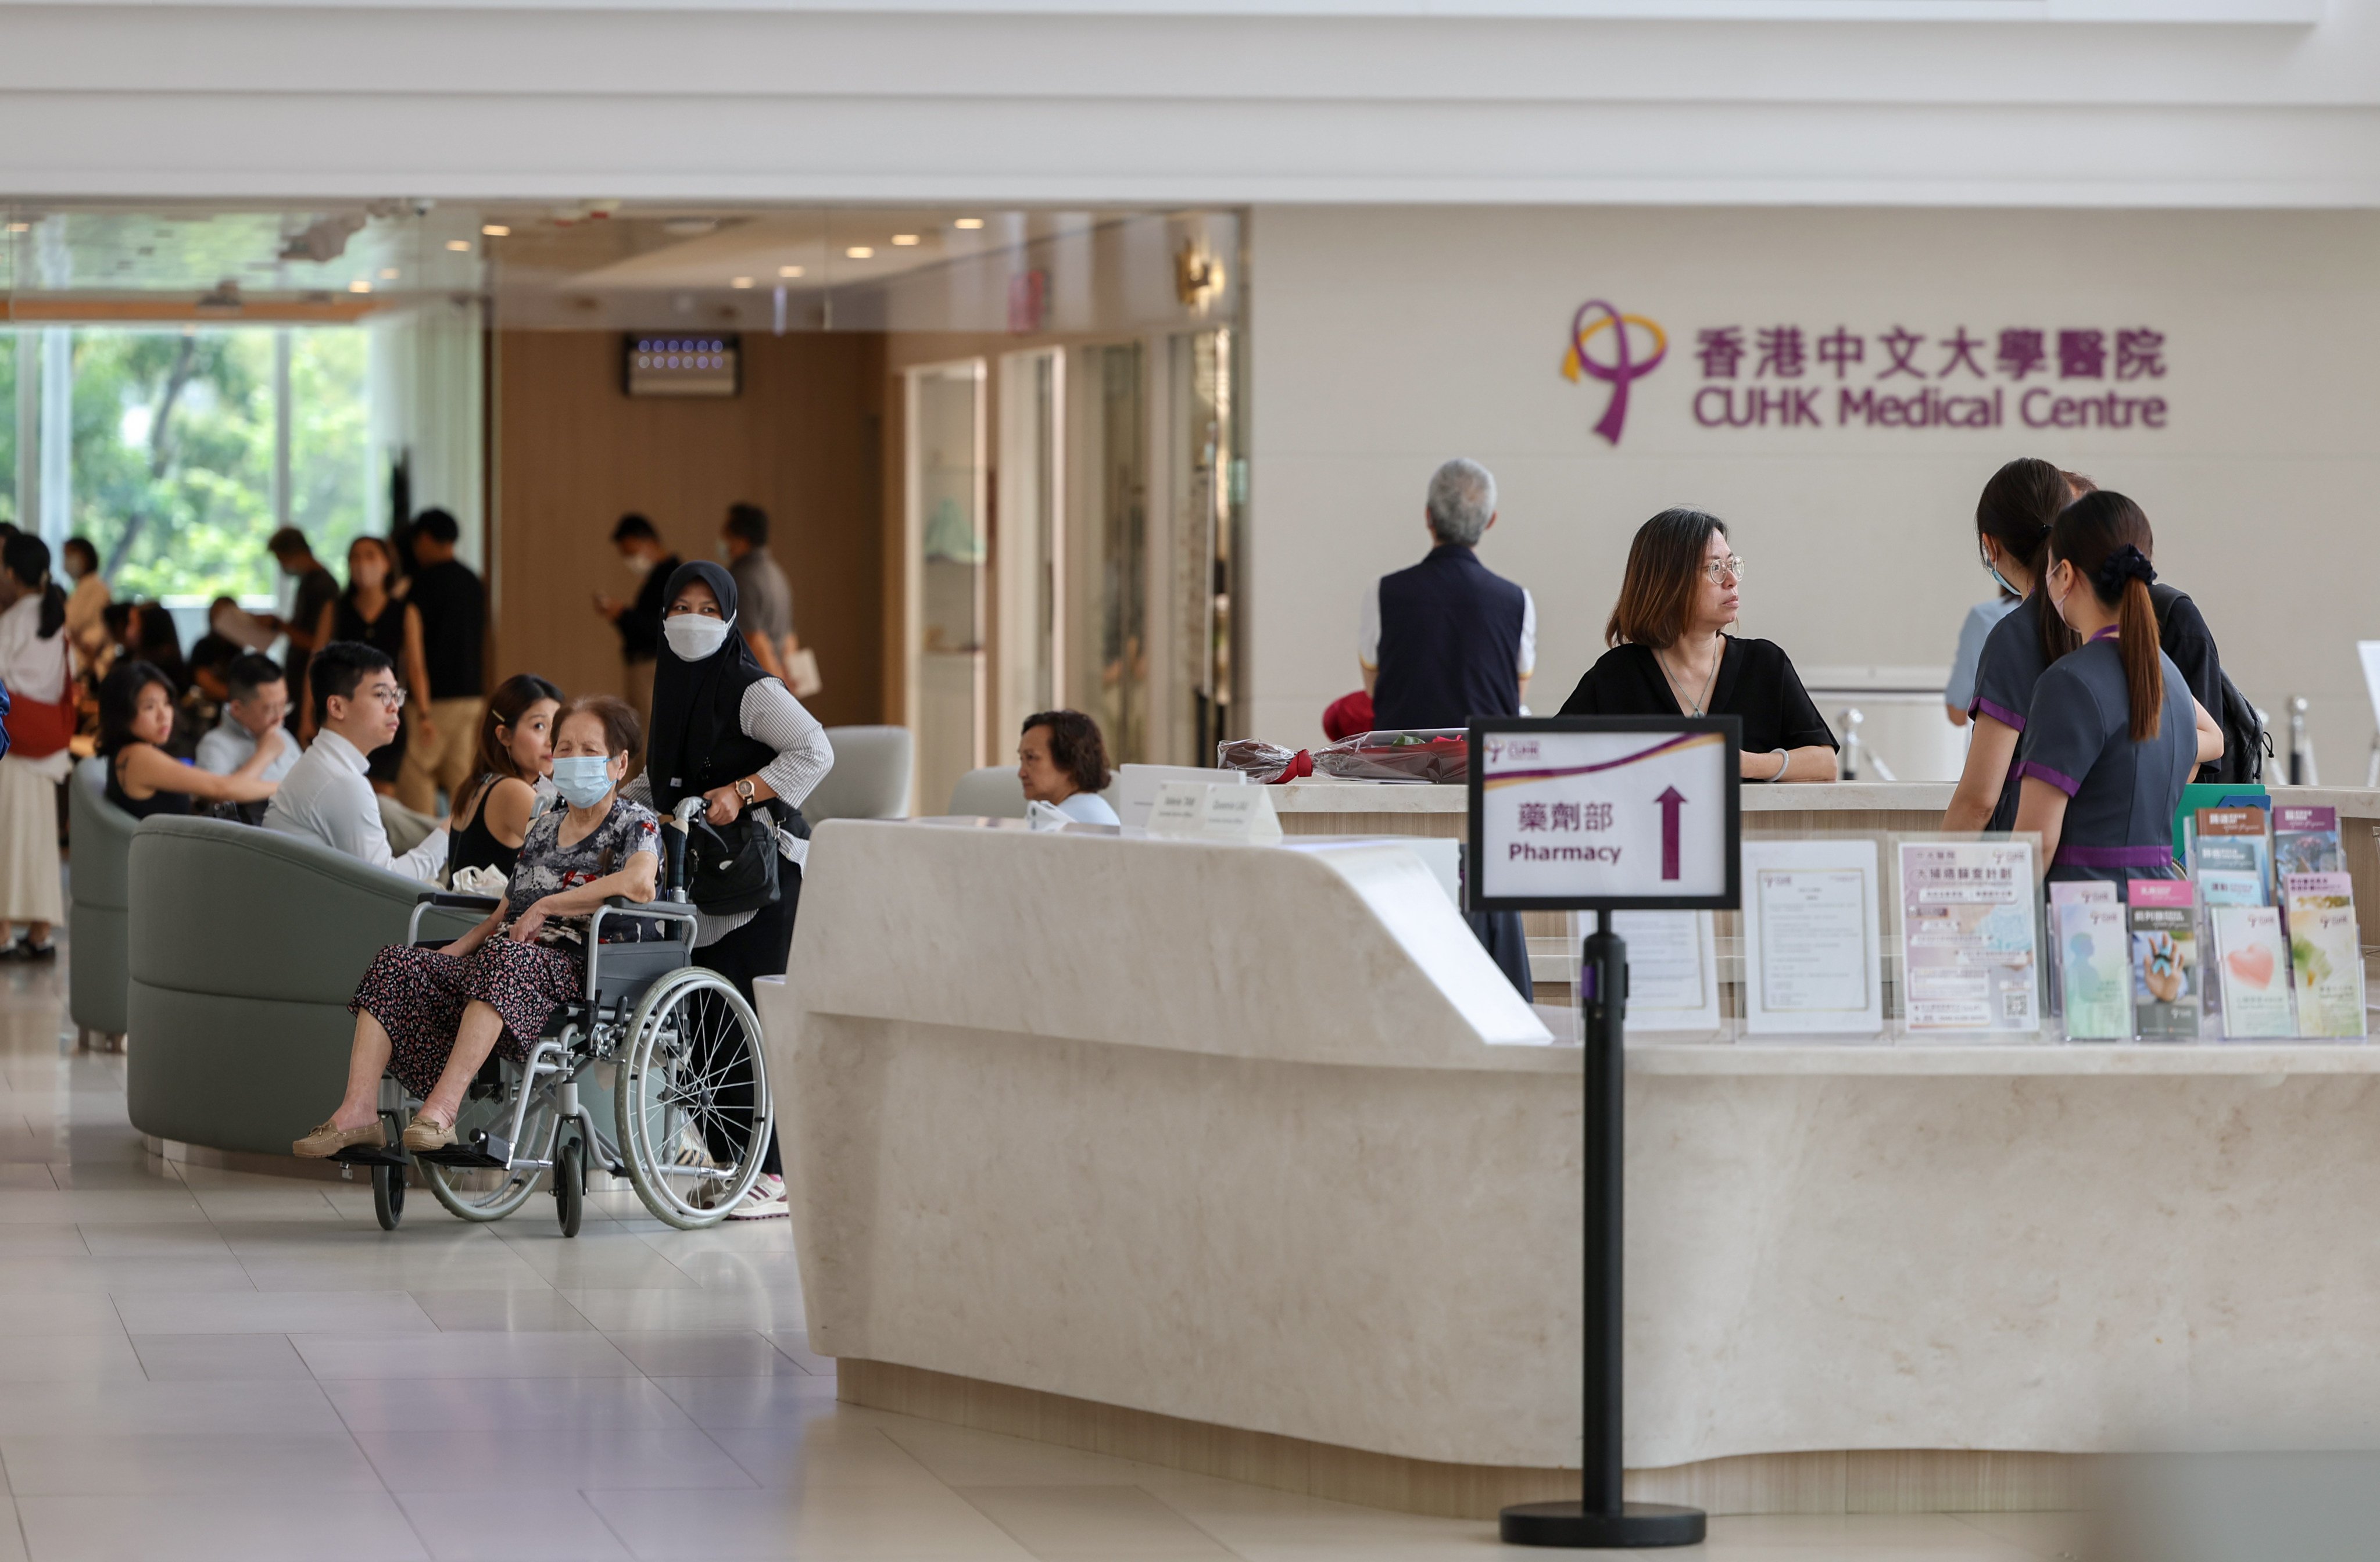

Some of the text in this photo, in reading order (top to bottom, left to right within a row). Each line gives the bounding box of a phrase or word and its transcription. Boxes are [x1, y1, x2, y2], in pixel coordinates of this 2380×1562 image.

[1694, 325, 2167, 382] 香港中文大學醫院
[1692, 387, 2167, 429] CUHK Medical Centre
[1518, 801, 1613, 832] 藥劑部
[1508, 842, 1622, 865] Pharmacy
